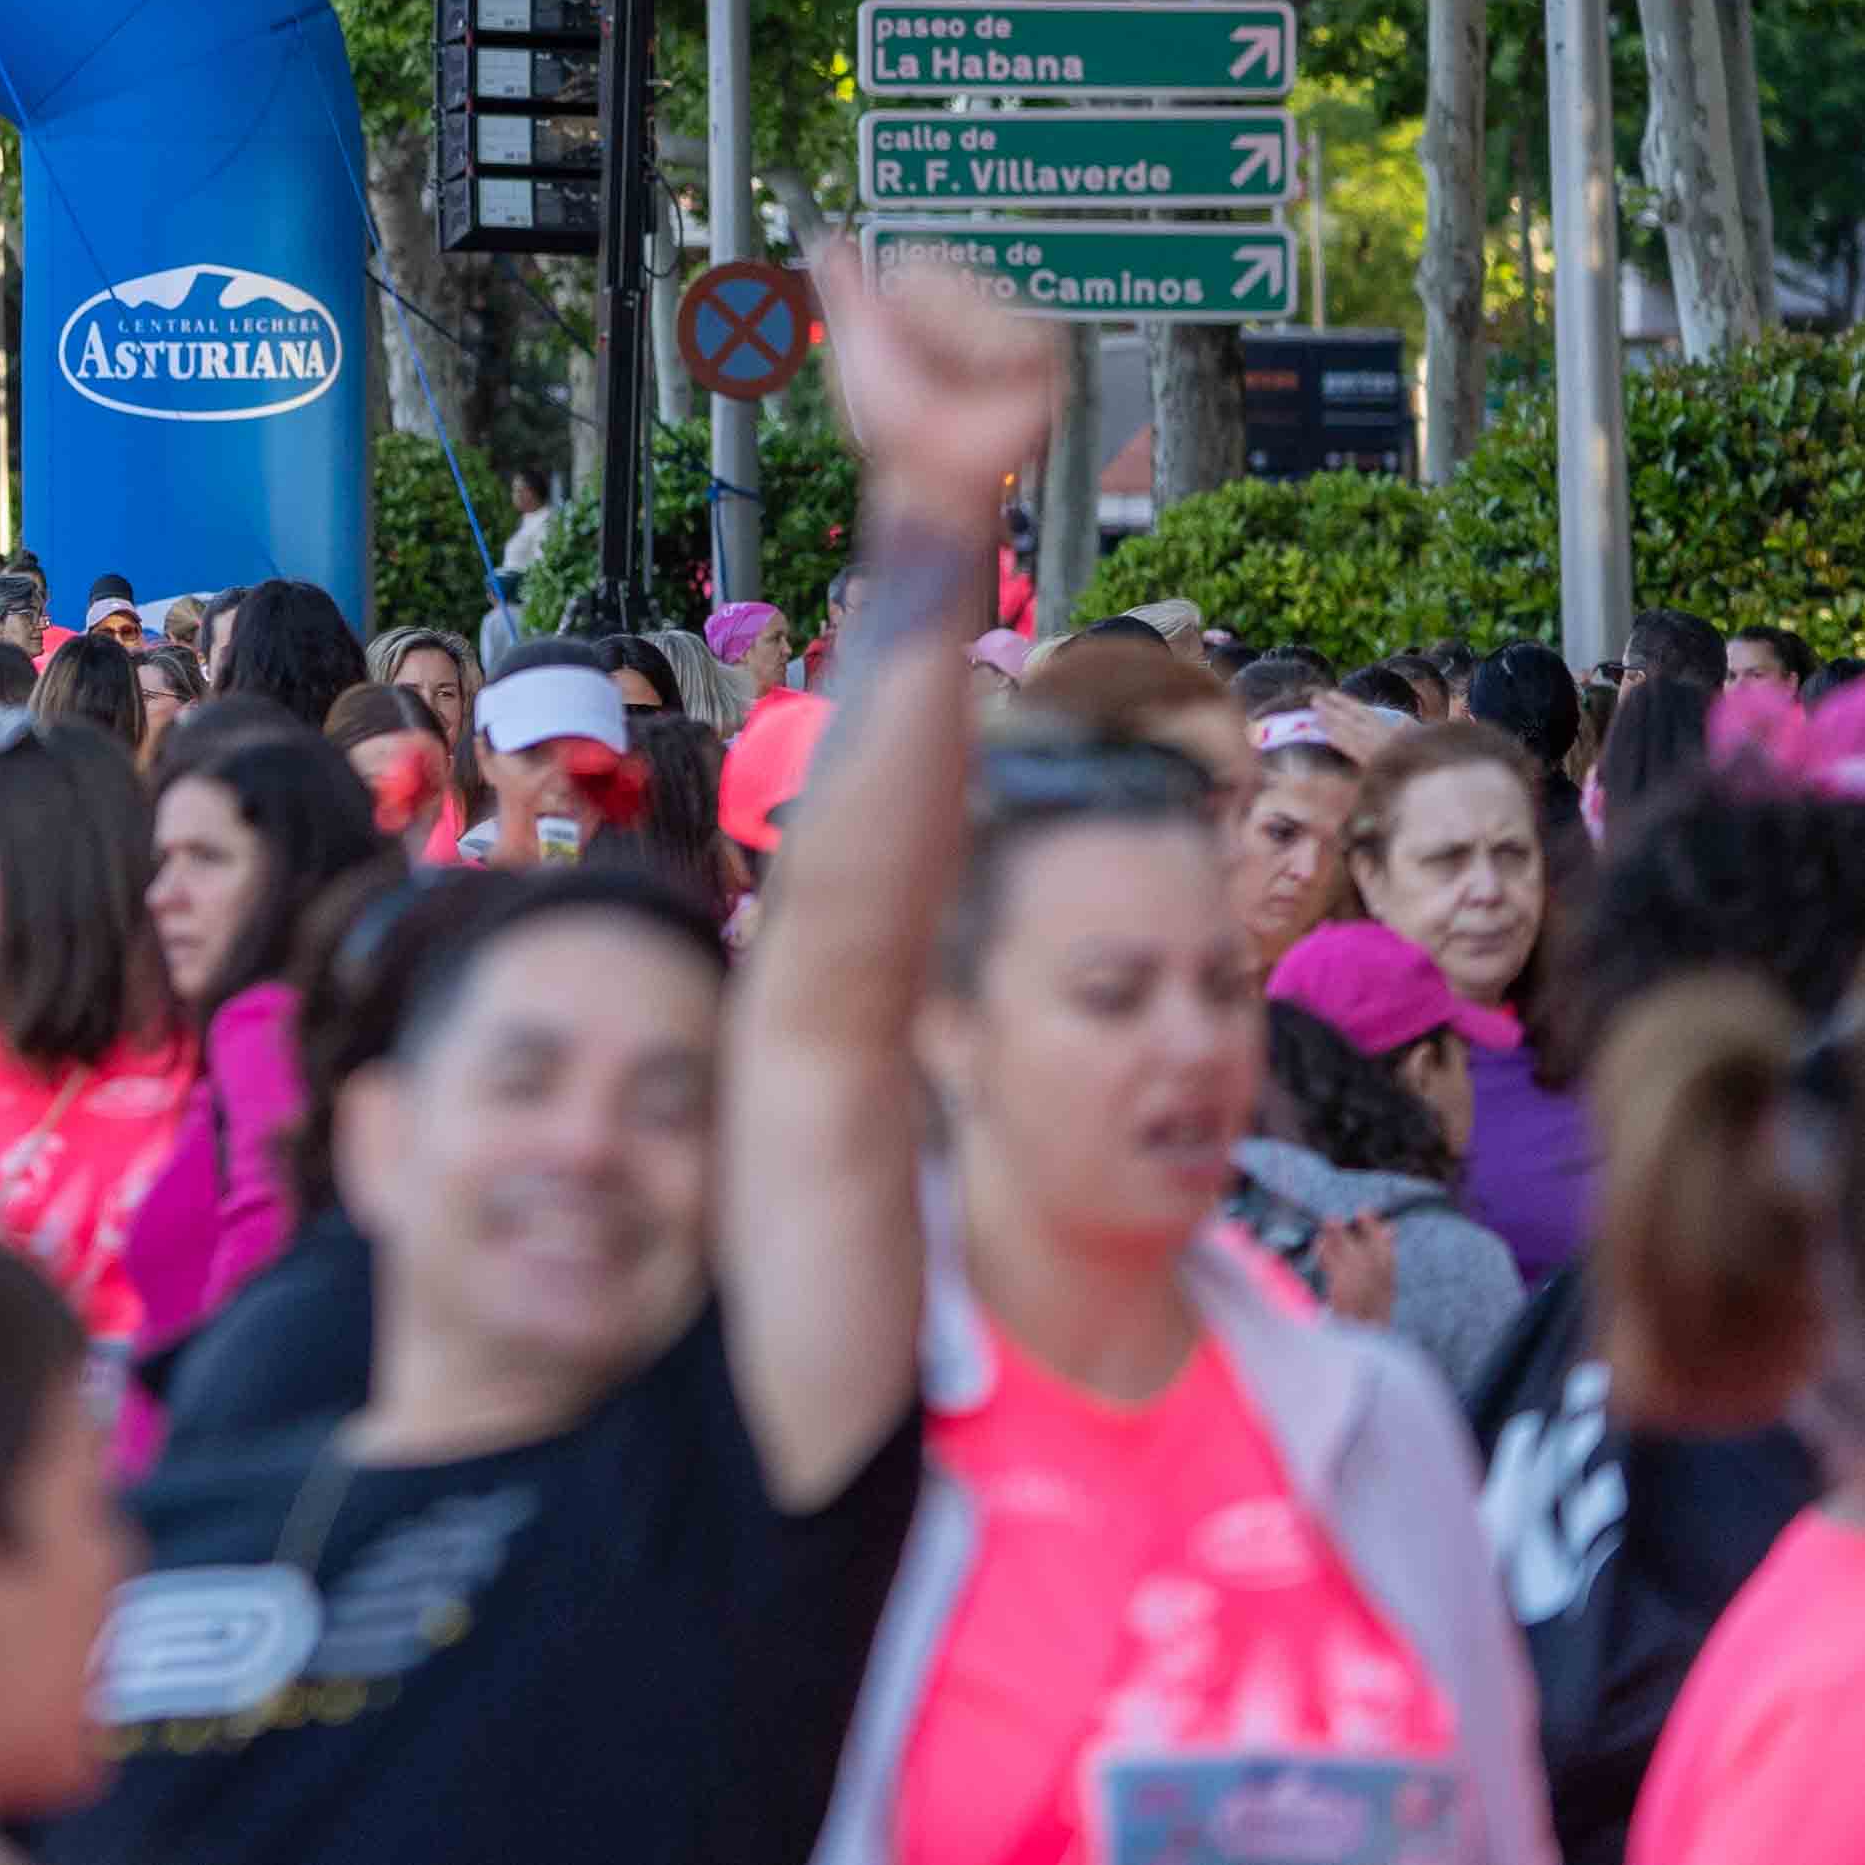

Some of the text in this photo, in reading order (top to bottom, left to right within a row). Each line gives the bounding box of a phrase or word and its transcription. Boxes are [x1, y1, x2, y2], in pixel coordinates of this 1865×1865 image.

[876, 15, 1012, 42] paseo de
[876, 47, 1084, 81] La Habana
[878, 126, 997, 150] calle de
[878, 160, 1172, 191] R. F. Villaverde
[1006, 240, 1043, 265] de
[1030, 270, 1203, 303] Caminos
[118, 317, 319, 333] CENTRAL LECHERA
[77, 321, 327, 380] ASTURIANA
